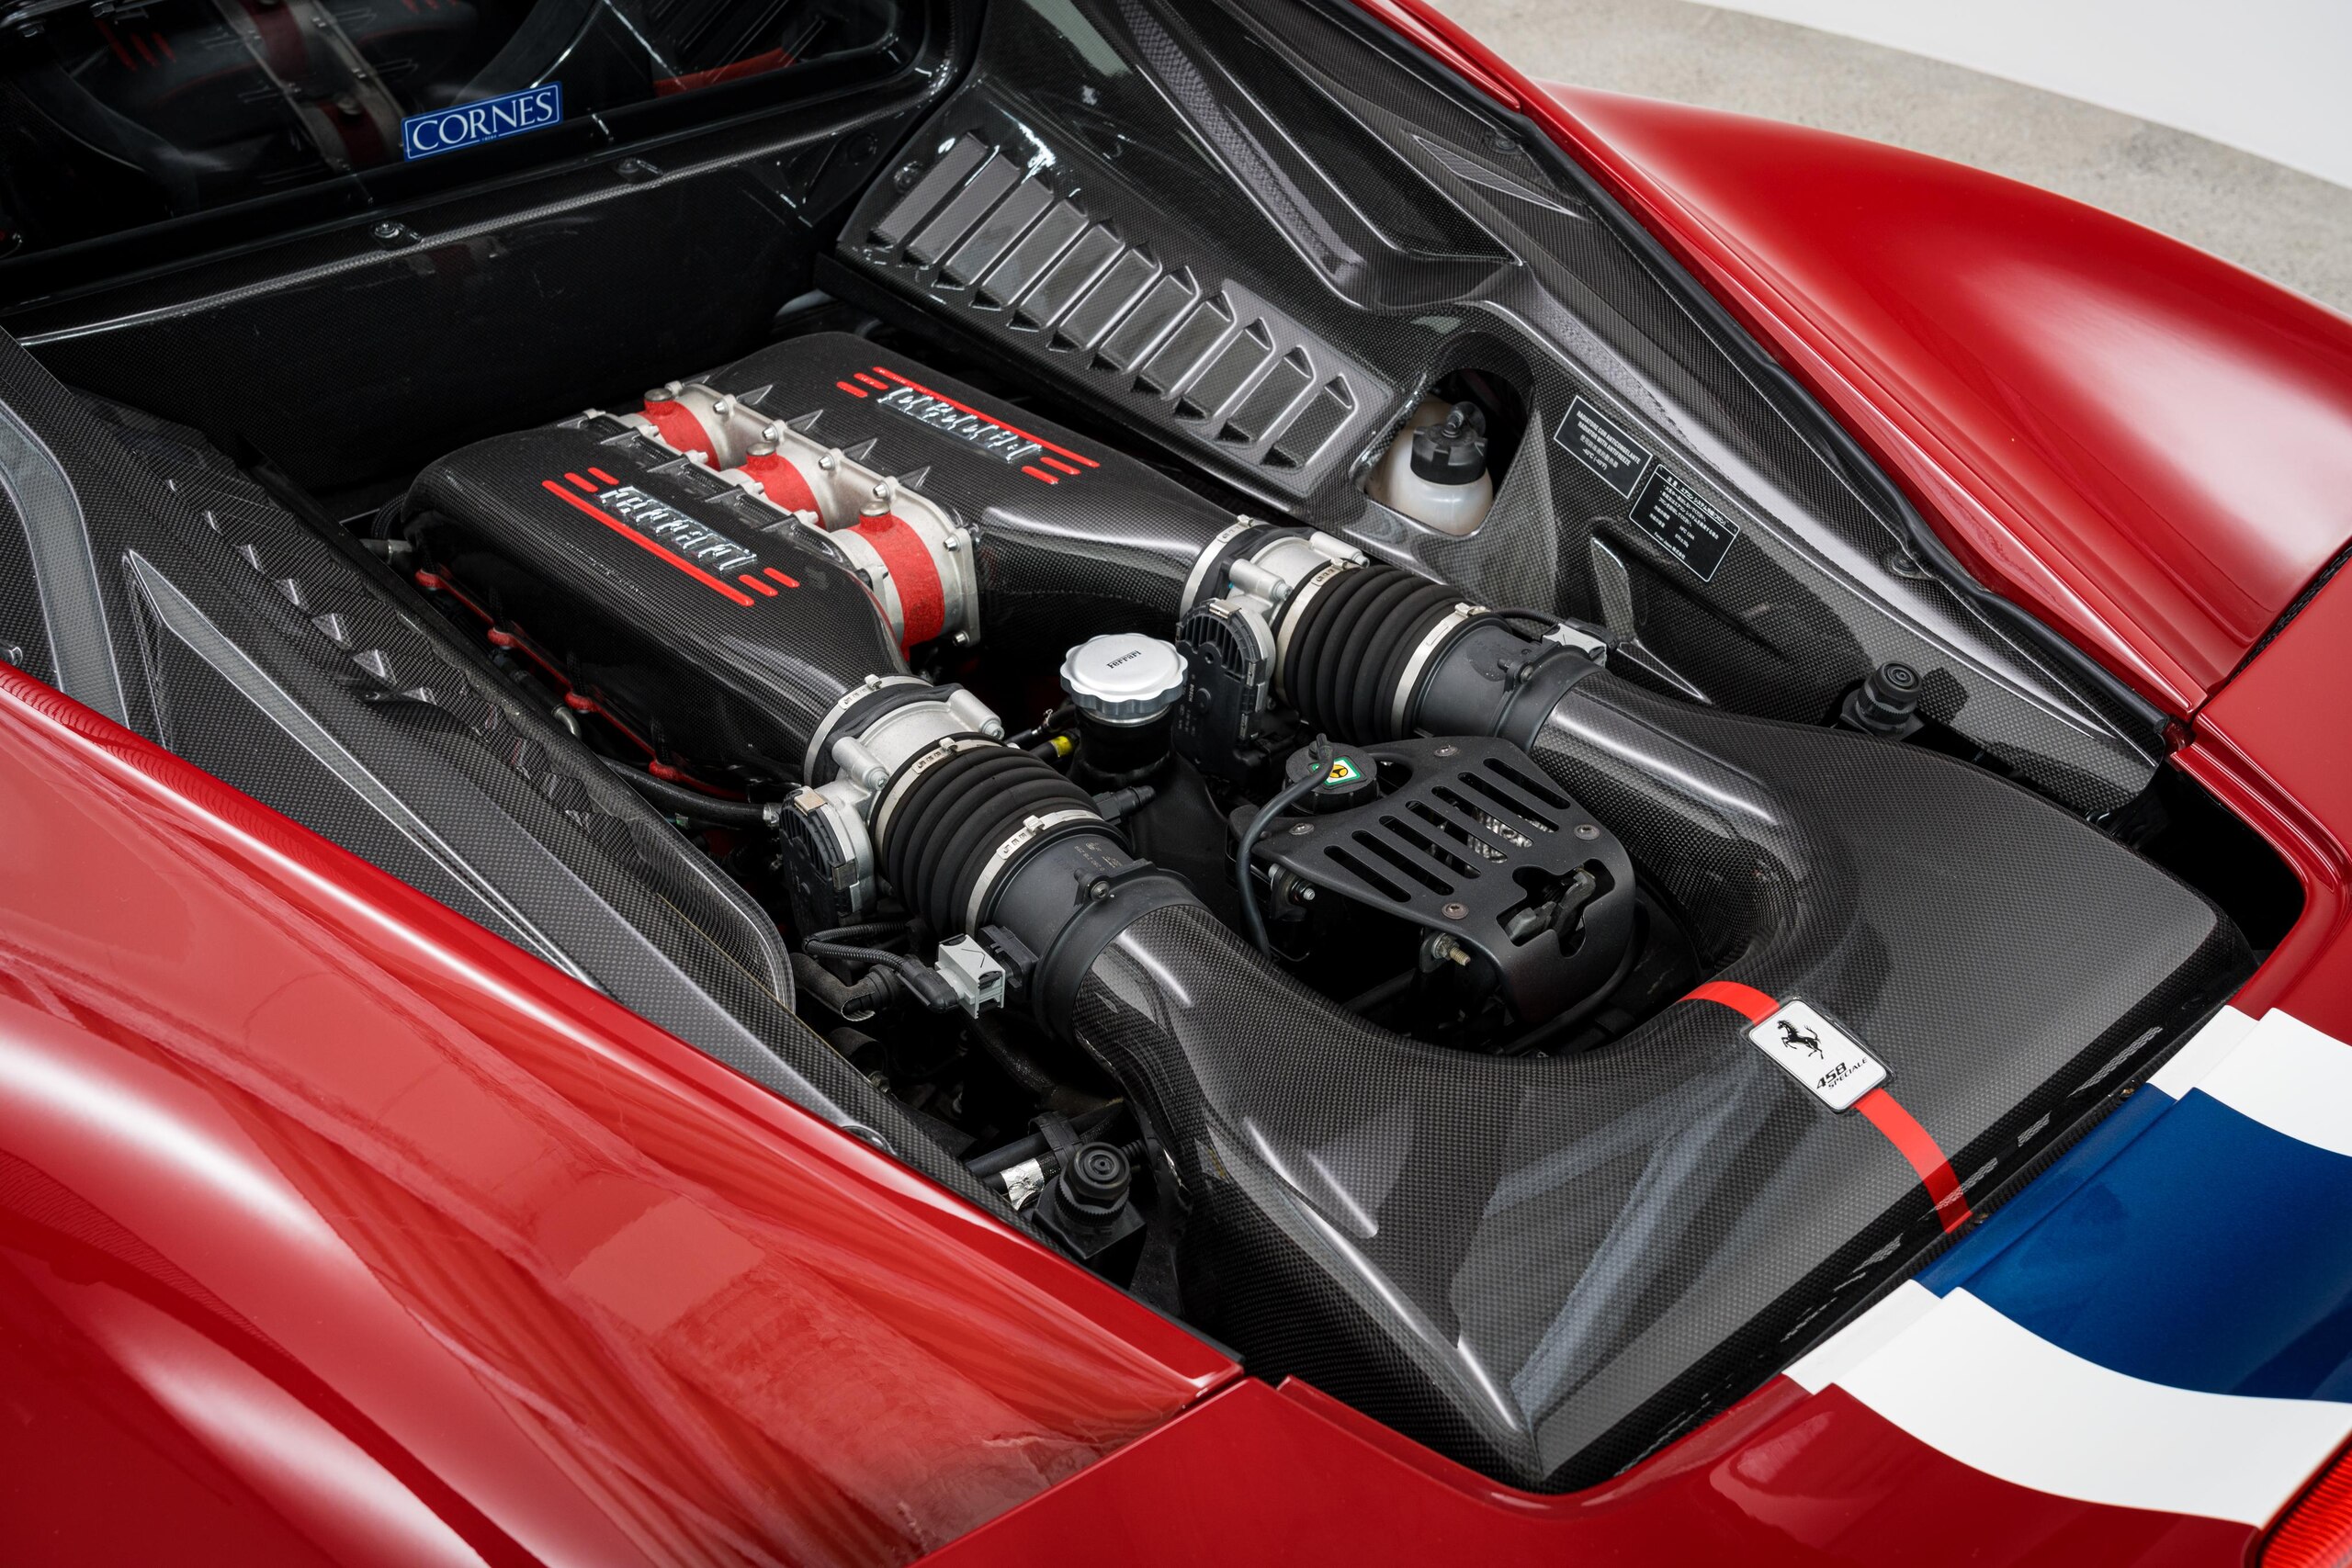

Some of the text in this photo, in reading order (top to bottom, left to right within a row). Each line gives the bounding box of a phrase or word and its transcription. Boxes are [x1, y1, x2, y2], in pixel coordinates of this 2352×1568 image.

[413, 92, 552, 151] CORNES
[1576, 410, 1641, 464] RADIATORE CON ANTICONGELANTE
[1577, 421, 1631, 466] RADIATOR WITH ANTIFREEZE
[1107, 650, 1142, 669] Ferrari
[1816, 1062, 1848, 1089] 458
[1827, 1056, 1868, 1089] SPECIALE
